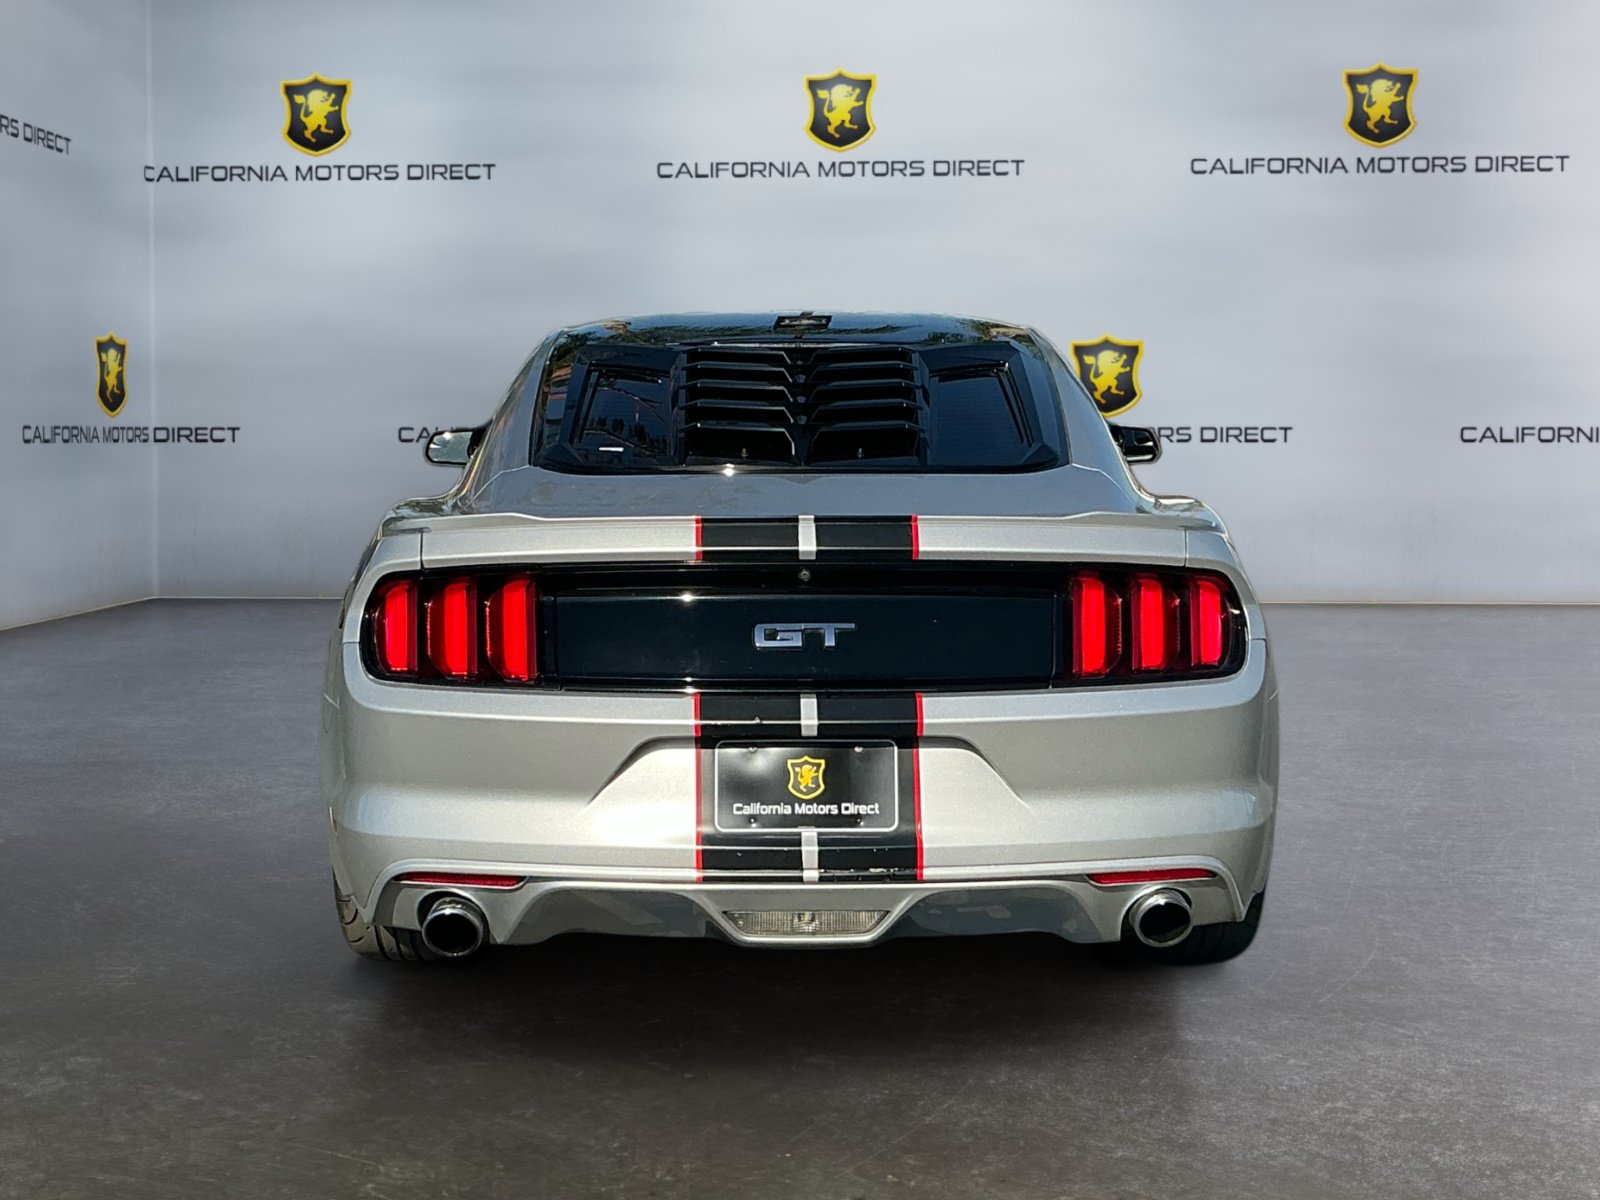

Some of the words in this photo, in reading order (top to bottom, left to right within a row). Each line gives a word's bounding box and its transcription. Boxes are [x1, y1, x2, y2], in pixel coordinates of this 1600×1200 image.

[0, 114, 20, 139] RS
[23, 122, 71, 155] DIRECT
[143, 165, 288, 183] CALIFORNIA
[295, 164, 399, 181] MOTORS
[407, 163, 496, 181] DIRECT
[656, 161, 810, 179] CALIFORNIA
[818, 160, 925, 178] MOTORS
[933, 159, 1025, 177] DIRECT
[1190, 157, 1349, 175] CALIFORNIA
[1356, 156, 1467, 174] MOTORS
[1475, 155, 1570, 173] DIRECT
[22, 425, 100, 444] CALIFORNIA
[102, 426, 149, 444] MOTORS
[153, 426, 240, 443] DIRECT
[1200, 426, 1293, 443] DIRECT
[1460, 426, 1600, 443] CALIFORNI
[754, 623, 855, 647] GT
[733, 802, 792, 815] California
[794, 802, 839, 815] Motors
[841, 802, 880, 815] Direct
